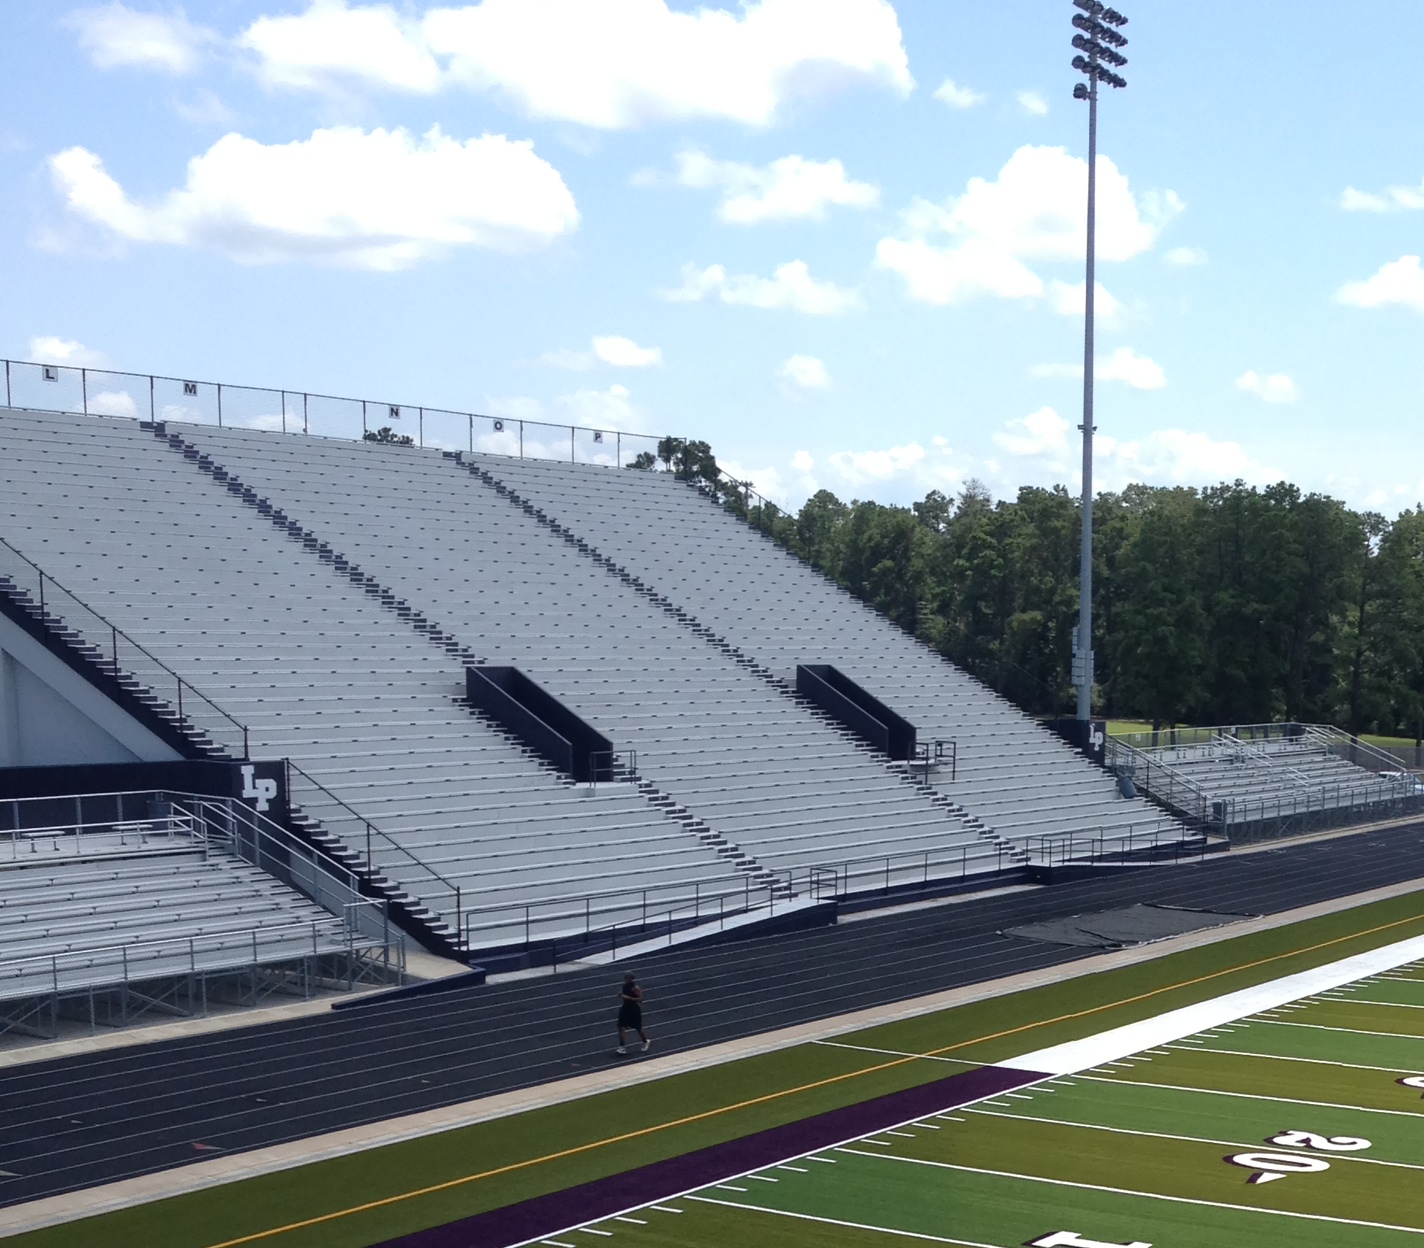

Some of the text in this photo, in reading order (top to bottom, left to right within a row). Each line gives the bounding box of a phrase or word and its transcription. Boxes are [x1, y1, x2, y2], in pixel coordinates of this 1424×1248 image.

[45, 368, 54, 379] L
[184, 383, 197, 394] M
[390, 407, 399, 417] N
[494, 421, 503, 431] O
[594, 432, 602, 442] P
[241, 765, 277, 811] LP
[1230, 1130, 1373, 1173] 20
